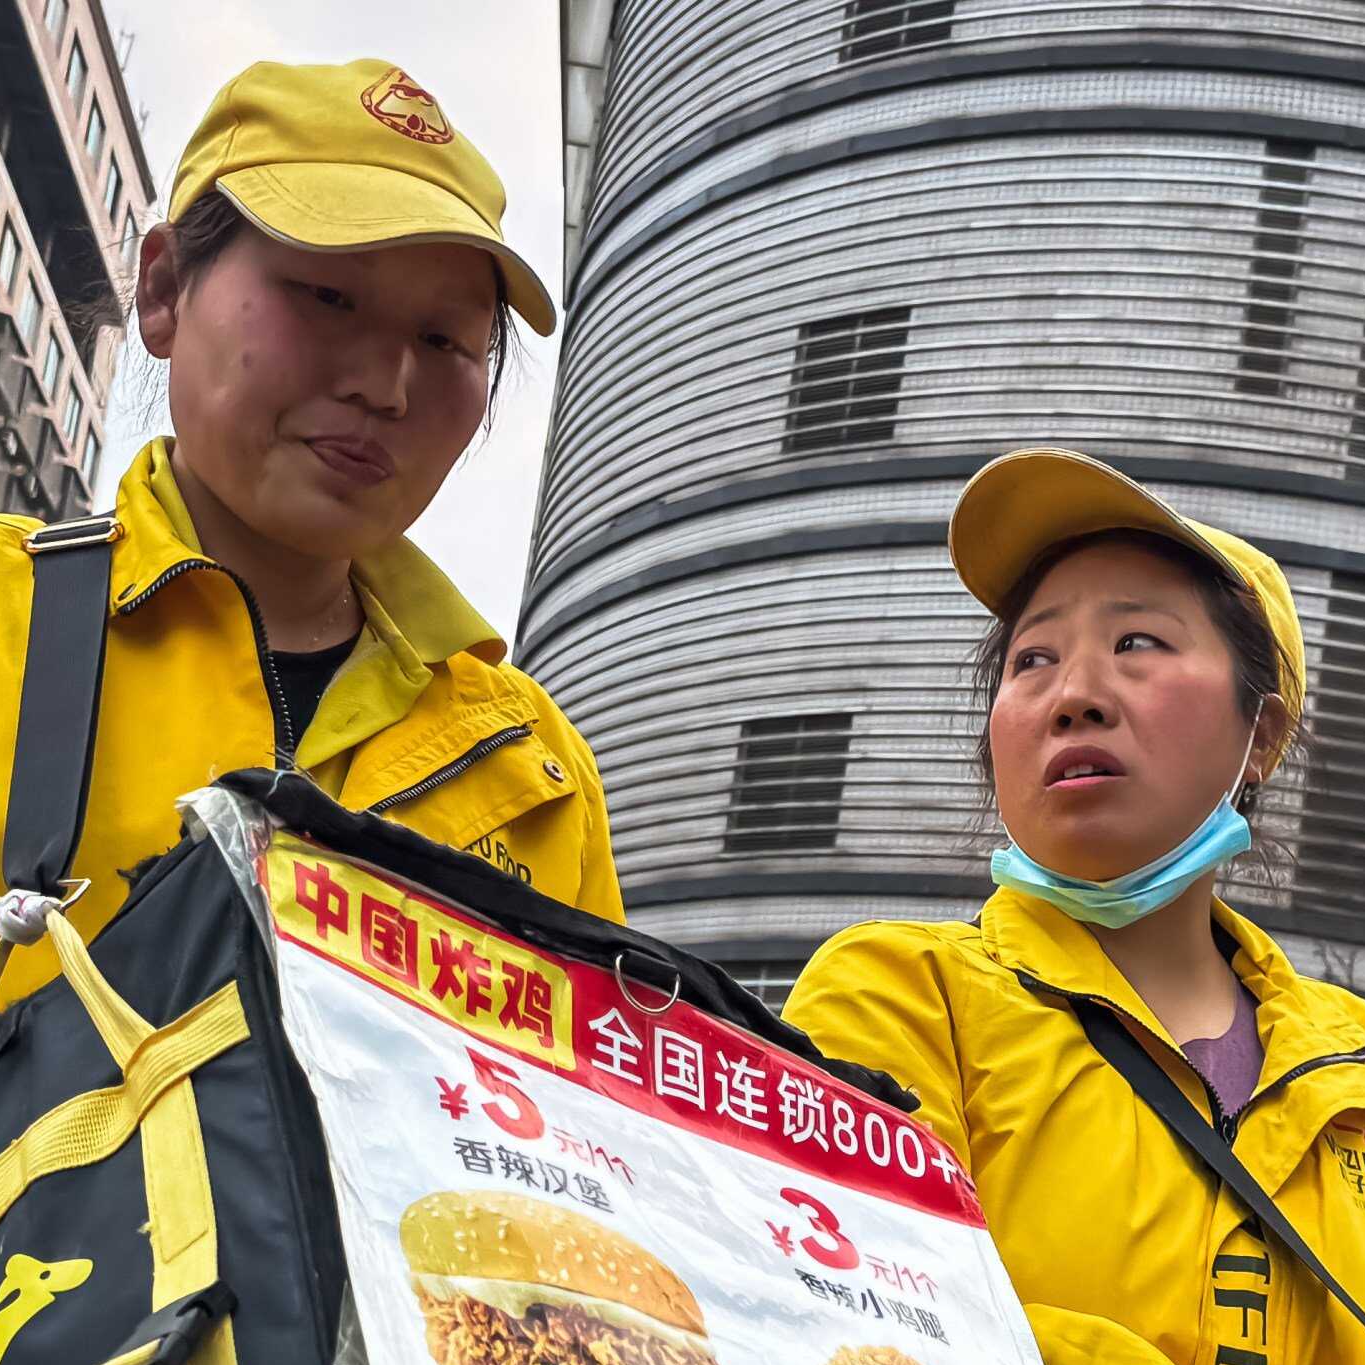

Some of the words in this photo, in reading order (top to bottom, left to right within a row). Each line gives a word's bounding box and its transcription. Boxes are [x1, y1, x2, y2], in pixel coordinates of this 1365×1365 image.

[295, 860, 555, 1050] 中国炸鸡
[453, 1136, 615, 1214] 香辣汉堡
[588, 1006, 969, 1187] 全国连锁800+
